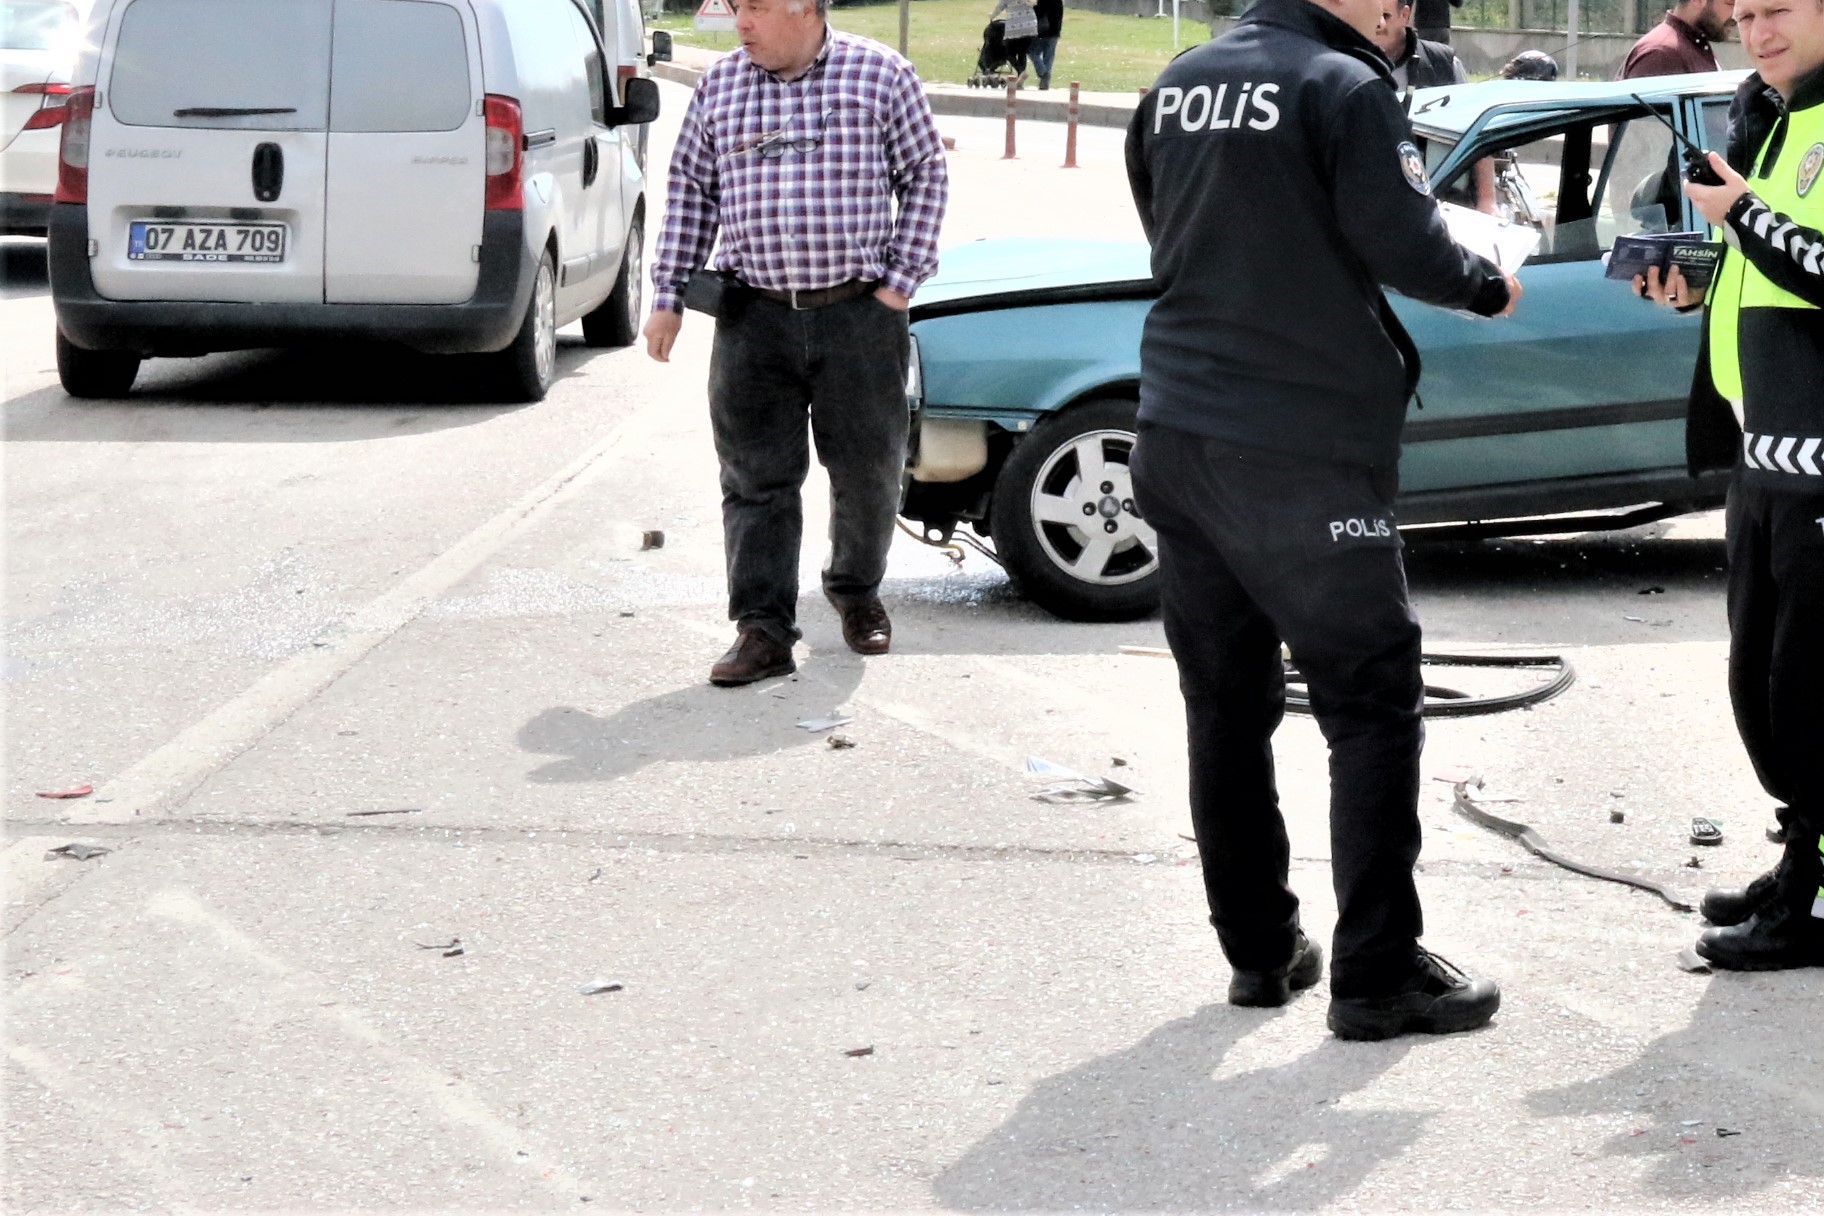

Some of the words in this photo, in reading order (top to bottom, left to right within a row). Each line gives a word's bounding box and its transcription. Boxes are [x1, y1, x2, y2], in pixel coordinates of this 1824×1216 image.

[1153, 82, 1281, 135] POLİS
[105, 148, 182, 159] PEUGEOT
[145, 228, 174, 250] 07
[182, 228, 227, 251] AZA
[236, 229, 280, 252] 709
[1673, 247, 1718, 258] TAHSİN
[1329, 515, 1391, 542] POLİS
